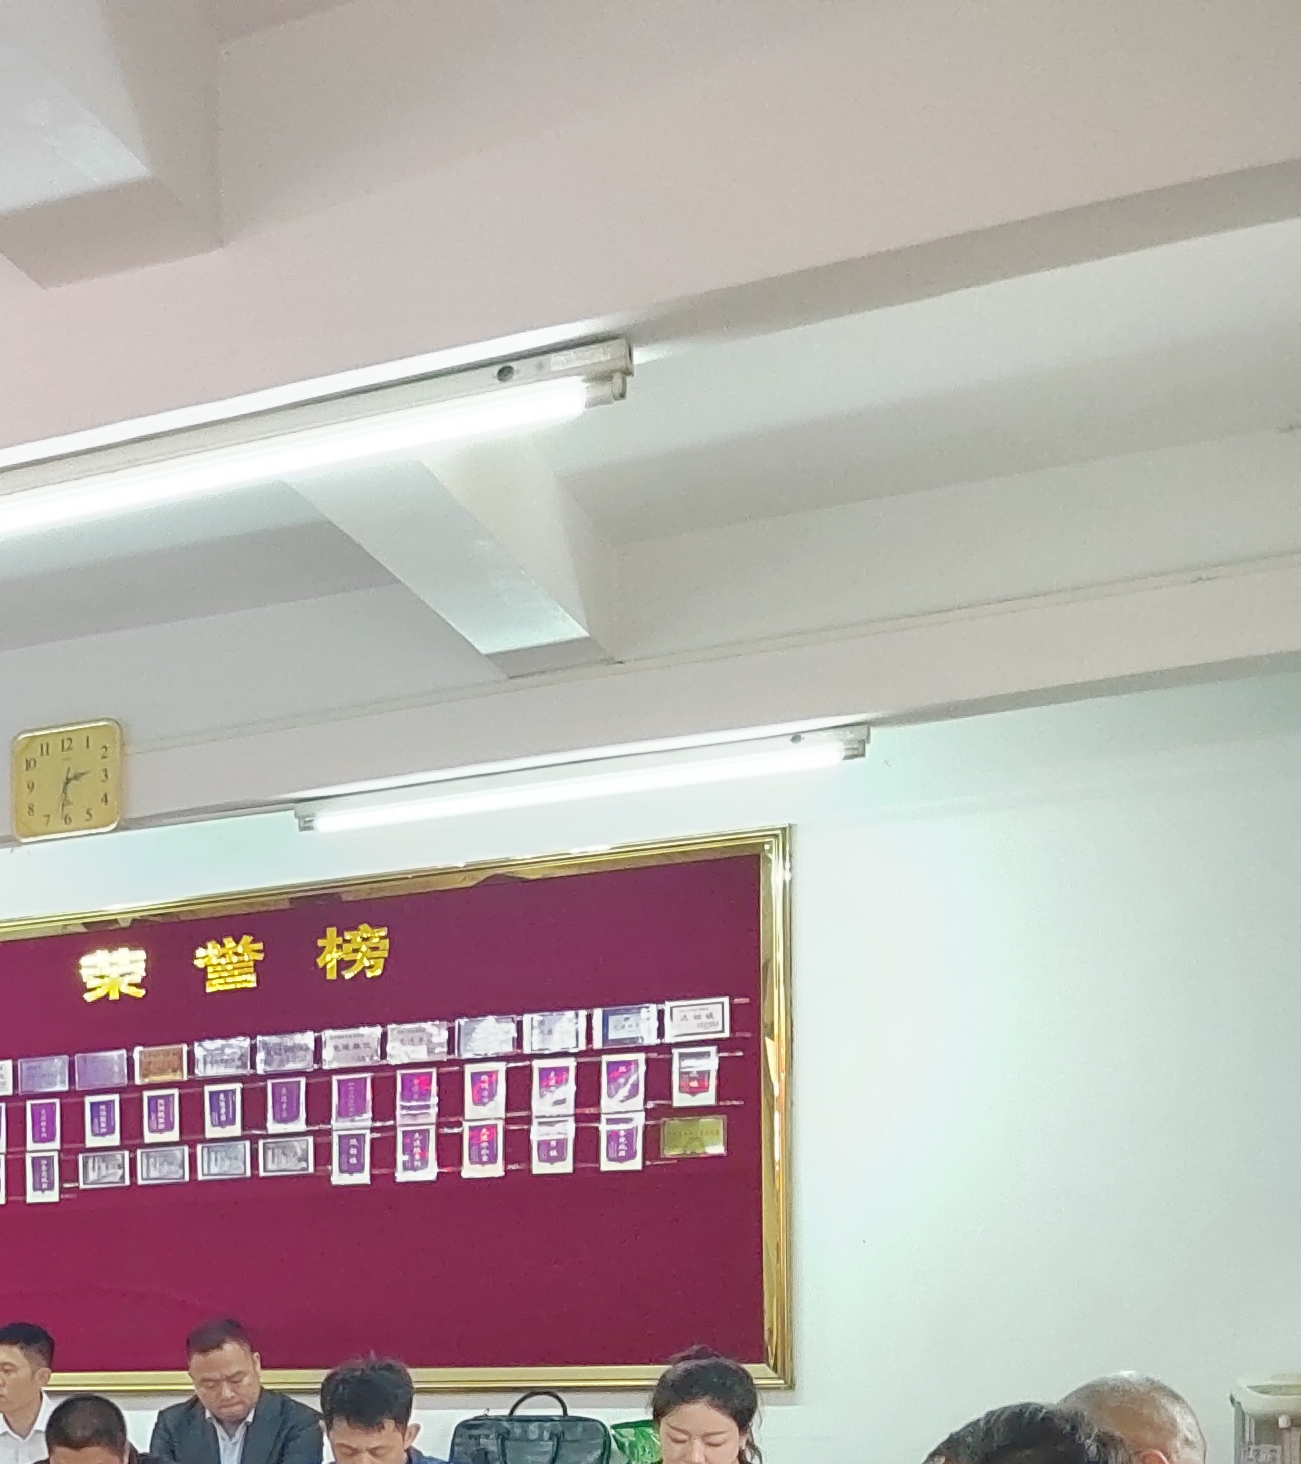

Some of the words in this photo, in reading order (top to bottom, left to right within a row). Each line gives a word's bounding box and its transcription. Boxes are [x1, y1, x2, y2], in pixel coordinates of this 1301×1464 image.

[40, 742, 50, 756] 11
[61, 737, 73, 752] 12
[85, 735, 90, 750] 1
[100, 744, 109, 759] 2
[25, 757, 36, 771] 10
[100, 768, 109, 782] 3
[26, 780, 35, 794] 9
[100, 792, 109, 806] 4
[27, 803, 35, 817] 8
[85, 807, 93, 822] 5
[43, 814, 51, 826] 7
[63, 813, 73, 826] 6
[79, 923, 390, 1003] 荣誉榜
